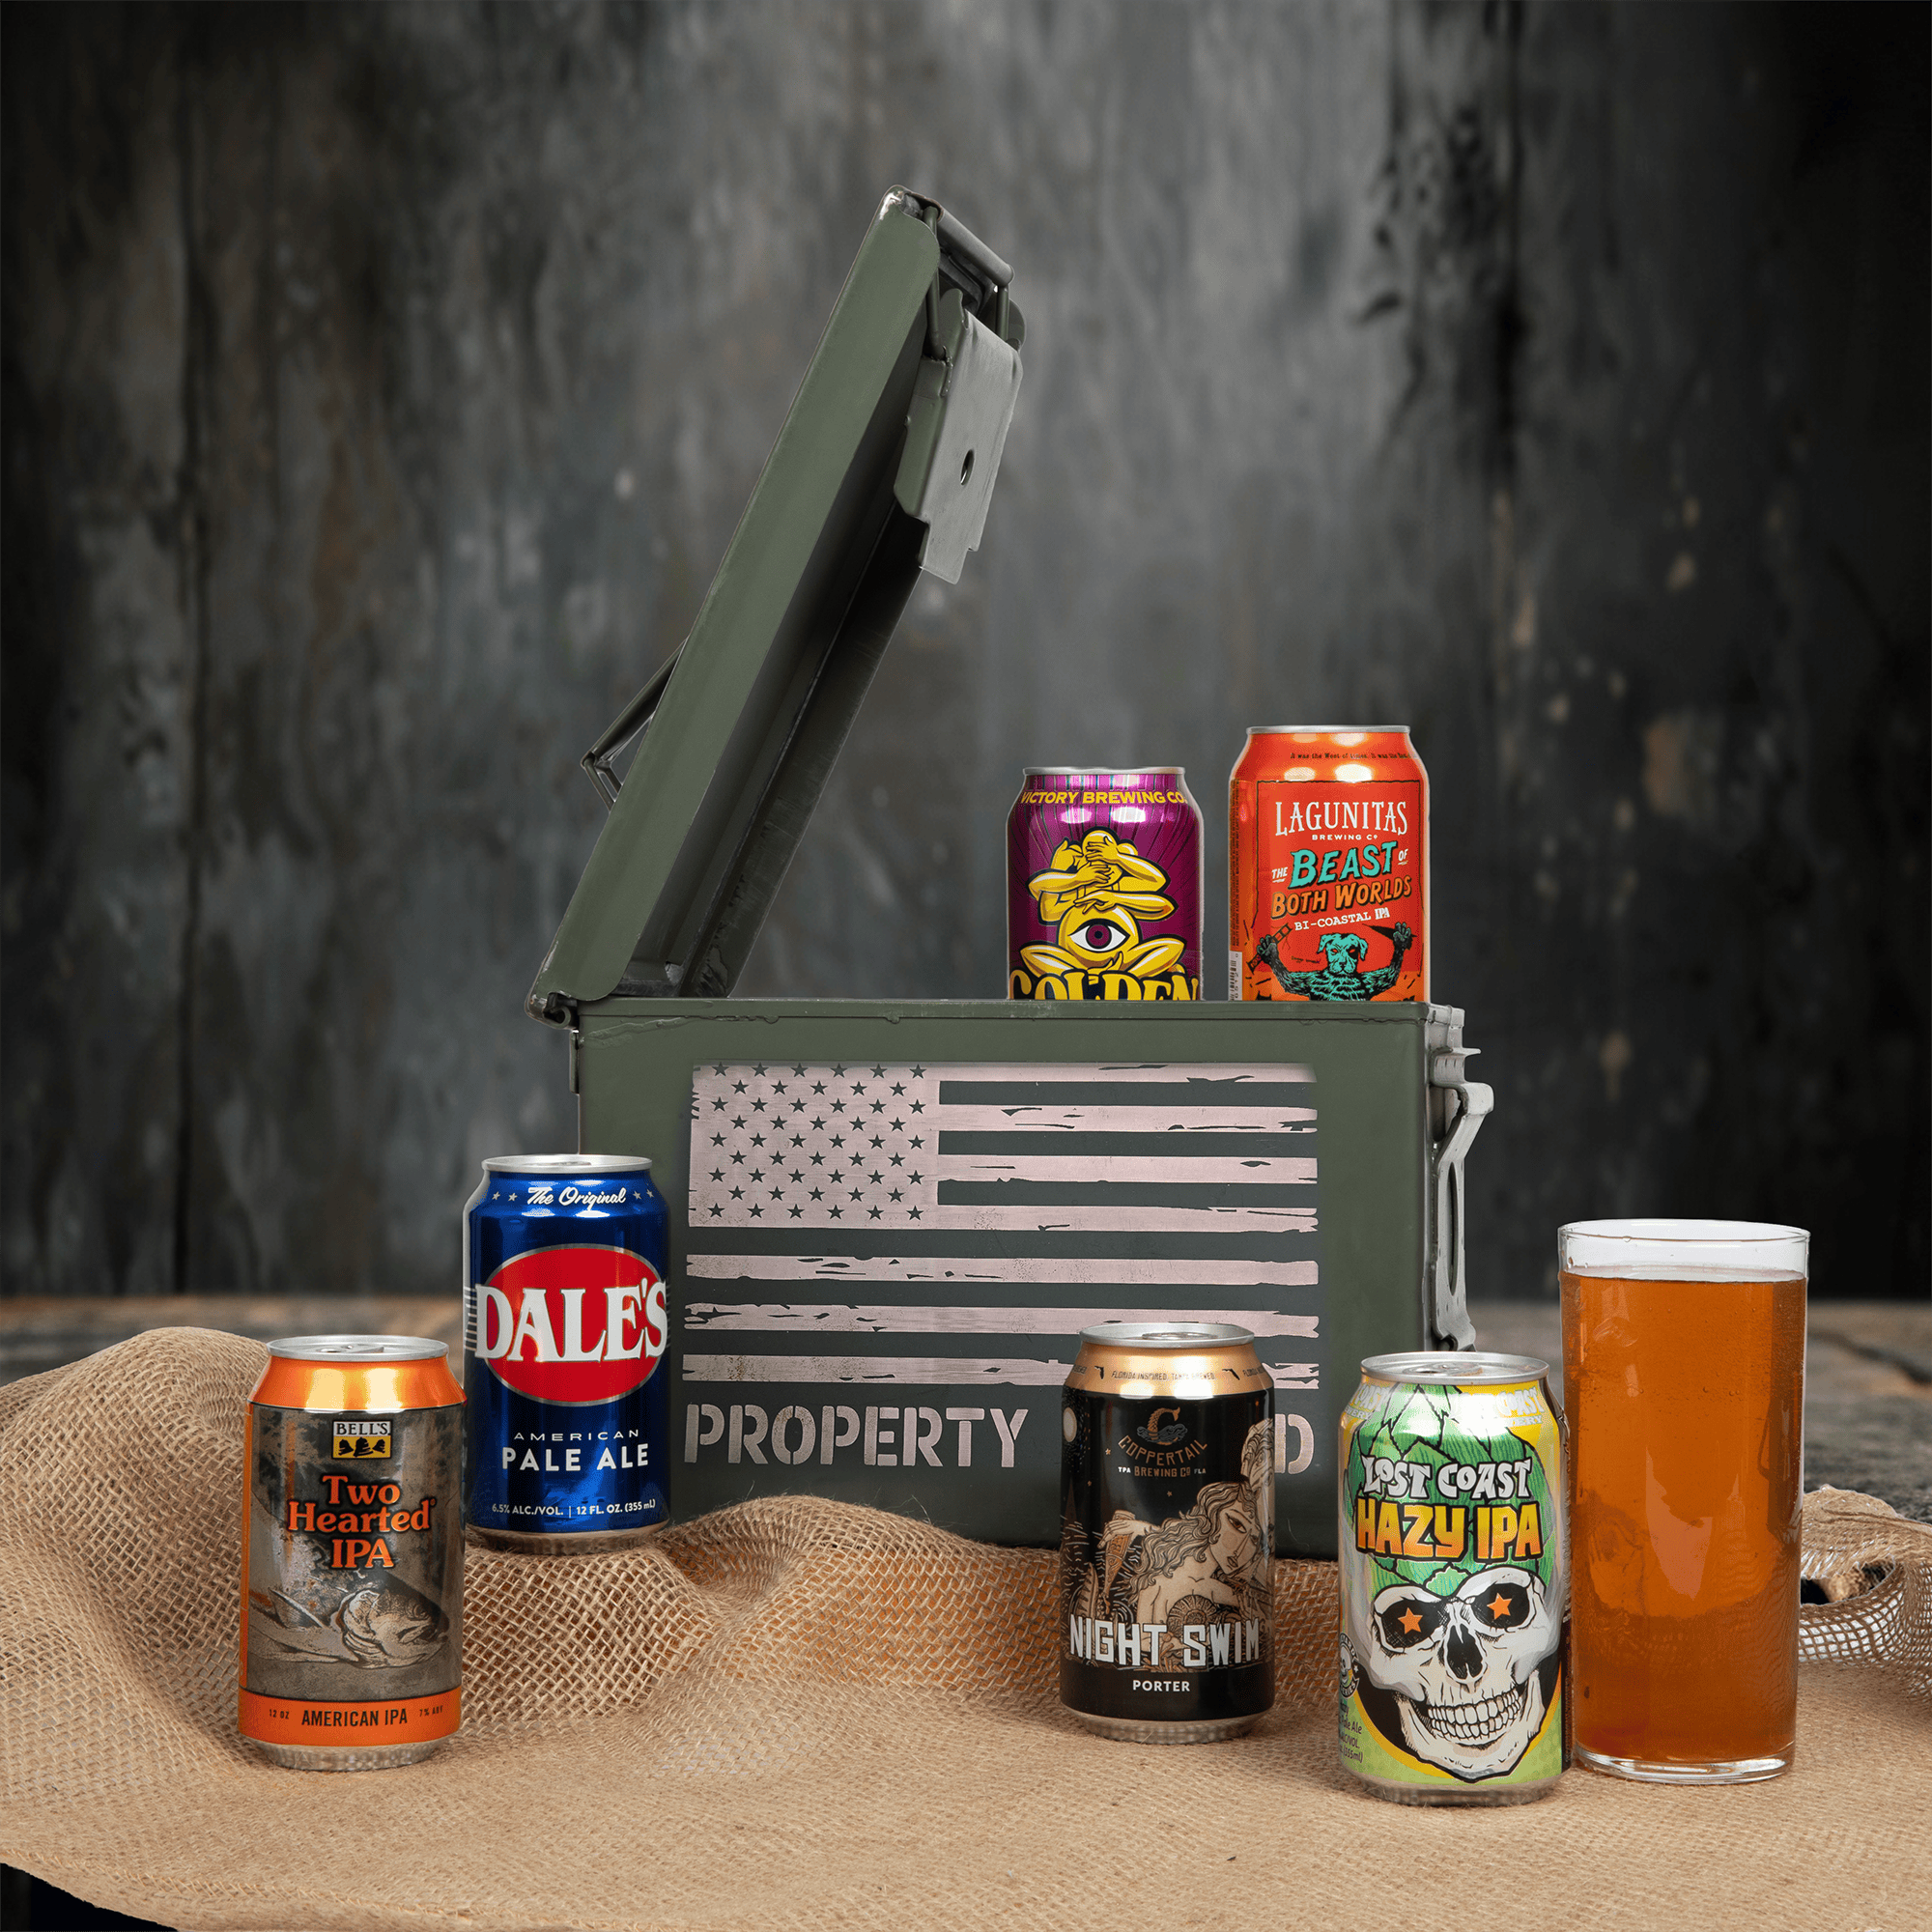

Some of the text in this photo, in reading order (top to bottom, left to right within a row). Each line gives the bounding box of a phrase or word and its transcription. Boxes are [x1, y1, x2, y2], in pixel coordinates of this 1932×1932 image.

[1021, 791, 1079, 804] VICTORY
[1082, 791, 1165, 804] BREWING
[1275, 801, 1407, 836] LAGUNITAS
[1271, 840, 1408, 890] THE BEAST OF
[1271, 875, 1411, 920] BOTH WORLDS
[1294, 907, 1391, 930] BI-COASTAL IPA
[527, 1186, 627, 1210] The Original
[474, 1277, 668, 1363] DALE'S
[336, 1422, 388, 1435] BELL'S
[514, 1429, 639, 1441] AMERICAN
[684, 1404, 1029, 1468] PROPERTY
[502, 1443, 648, 1471] PALE ALE
[1118, 1435, 1208, 1465] COPPERTAIL
[1134, 1465, 1178, 1477] BREWING
[1361, 1455, 1534, 1498] LOST COAST
[322, 1475, 401, 1504] Two
[492, 1502, 510, 1514] 6.5%
[577, 1506, 587, 1515] 12
[589, 1505, 605, 1515] FL.
[607, 1503, 623, 1514] OZ.
[624, 1501, 642, 1513] (355
[1356, 1497, 1544, 1560] HAZY IPA
[331, 1538, 394, 1569] IPA
[1070, 1614, 1260, 1666] NIGHT SWIM
[1132, 1679, 1190, 1691] PORTER
[269, 1709, 277, 1718] 12
[280, 1711, 290, 1719] OZ
[301, 1709, 379, 1726] AMERICAN
[384, 1708, 408, 1725] IPA
[419, 1708, 430, 1717] 7%
